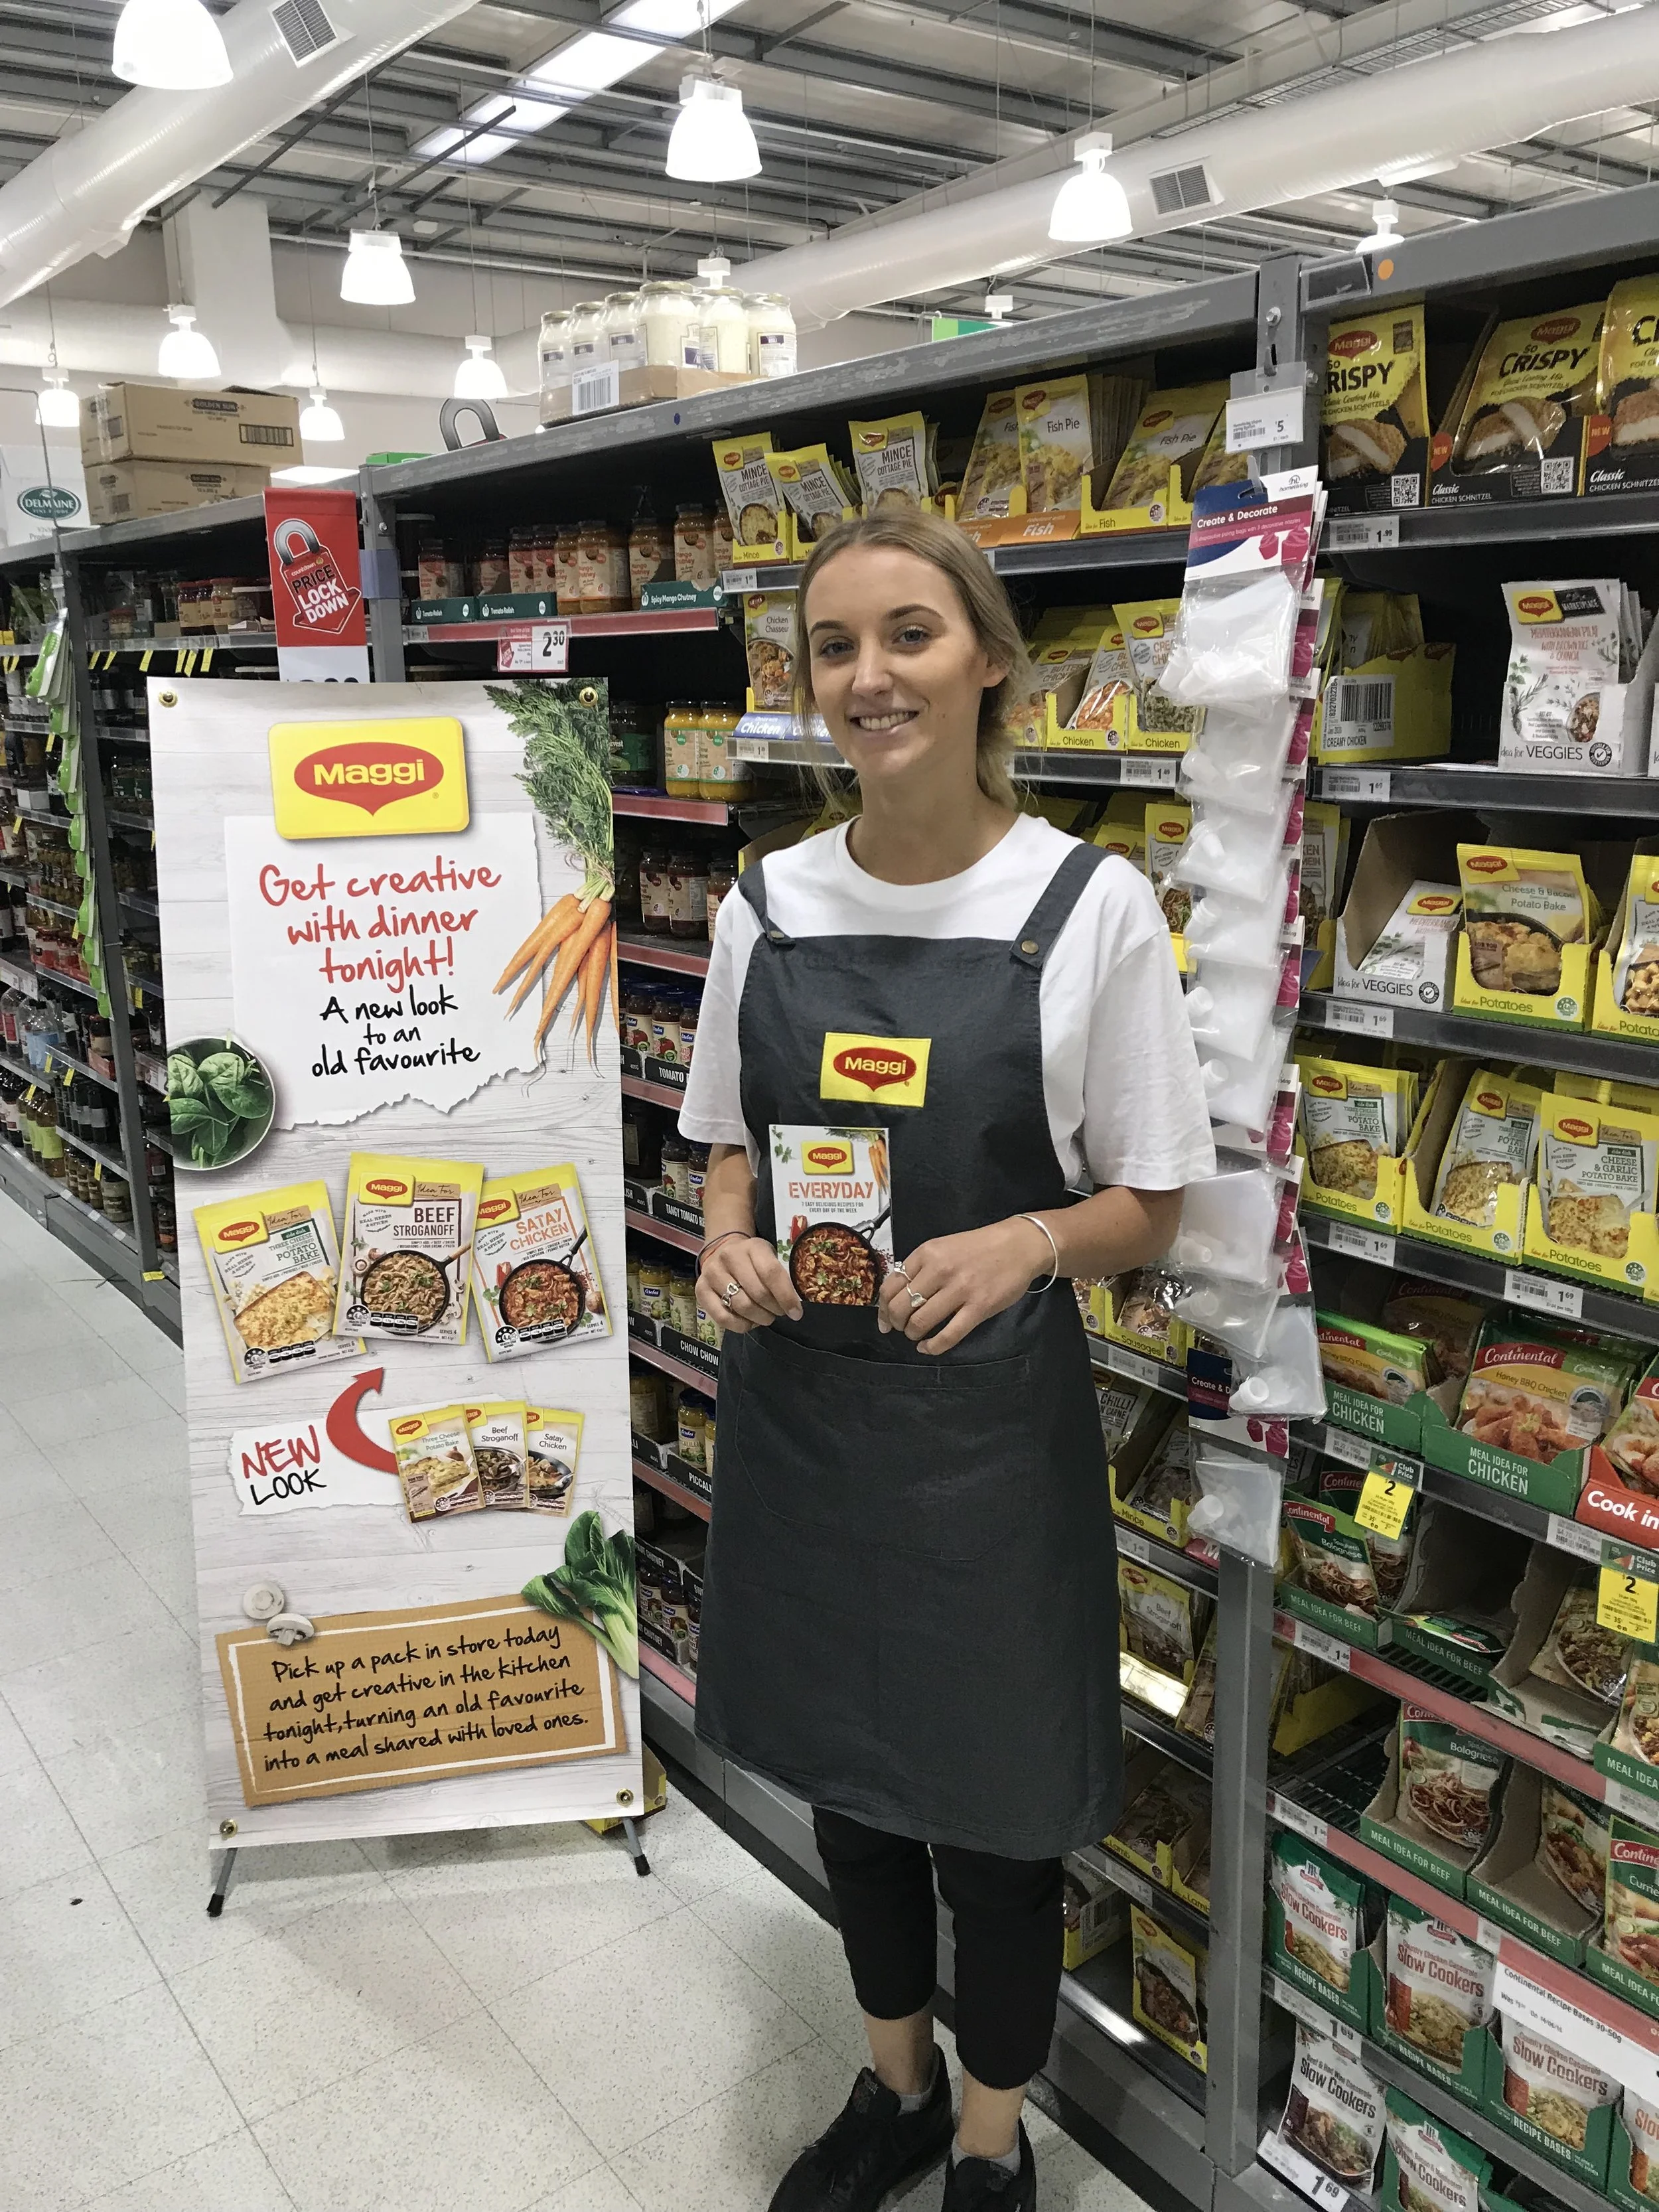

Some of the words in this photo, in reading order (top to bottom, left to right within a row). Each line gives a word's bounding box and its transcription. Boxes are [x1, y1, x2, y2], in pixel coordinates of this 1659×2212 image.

[1499, 347, 1591, 378] CRISPY
[1329, 361, 1394, 394] RISPY
[1048, 420, 1062, 432] Fish
[1064, 418, 1080, 430] Pie
[1591, 426, 1610, 437] NEW
[882, 445, 911, 464] MINCE
[1433, 446, 1447, 455] NEW
[1590, 469, 1626, 482] Classic
[1432, 483, 1460, 496] Classic
[1099, 518, 1116, 528] Fish
[1198, 513, 1226, 528] Create
[1228, 513, 1234, 522] &
[1238, 505, 1277, 519] Decorate
[291, 564, 335, 594] PRICE
[298, 578, 342, 610] LOCK
[651, 595, 661, 604] Spicy
[678, 592, 697, 602] Chutney
[305, 593, 349, 623] DOWN
[766, 616, 788, 625] Chicken
[741, 723, 780, 735] Chicken
[1062, 737, 1095, 747] Chicken
[1145, 738, 1181, 749] Chicken
[1328, 737, 1346, 747] CREAMY
[1347, 735, 1367, 746] CHICKEN
[1526, 745, 1583, 761] VEGGIES
[313, 759, 425, 786] Maggi
[259, 863, 335, 907] Get
[346, 855, 502, 899] creative
[1502, 884, 1536, 895] Cheese
[1510, 898, 1540, 910] Potato
[1543, 900, 1567, 911] Bake
[287, 905, 358, 946] with
[368, 906, 478, 938] dinner
[319, 936, 455, 993] tonight!
[1362, 978, 1413, 997] VEGGIES
[319, 995, 348, 1023] A
[356, 999, 403, 1021] new
[409, 985, 459, 1015] look
[1479, 995, 1533, 1013] Potatoes
[363, 1023, 387, 1045] to
[394, 1025, 421, 1043] an
[312, 1045, 346, 1077] old
[354, 1042, 480, 1075] favourite
[845, 1056, 907, 1075] Maggi
[659, 1067, 684, 1083] TOMATO
[1348, 1116, 1379, 1125] POTATO
[1359, 1124, 1381, 1132] BAKE
[1601, 1156, 1638, 1166] CHEESE
[1603, 1164, 1638, 1175] GARLIC
[1582, 1171, 1614, 1181] POTATO
[1616, 1173, 1638, 1183] BAKE
[371, 1183, 403, 1193] Maggi
[417, 1183, 437, 1193] Idea
[788, 1181, 874, 1199] EVERYDAY
[1316, 1192, 1357, 1212] Potatoes
[414, 1207, 455, 1223] BEEF
[516, 1208, 563, 1234] SATAY
[666, 1203, 680, 1218] TANGY
[680, 1209, 698, 1226] TOMATO
[223, 1224, 255, 1238] Maggi
[394, 1225, 455, 1237] STROGANOFF
[510, 1222, 569, 1250] CHICKEN
[1425, 1222, 1472, 1242] Potatoes
[269, 1239, 288, 1251] THREE
[289, 1233, 313, 1245] CHEESE
[277, 1243, 317, 1261] POTATO
[294, 1250, 319, 1264] BAKE
[1550, 1249, 1602, 1272] Potatoes
[680, 1339, 698, 1357] CHOW
[699, 1348, 719, 1366] CHOW
[1121, 1334, 1161, 1357] Sausages
[1484, 1346, 1558, 1364] Continental
[1496, 1370, 1519, 1384] Honey
[1520, 1377, 1537, 1390] BBQ
[1538, 1382, 1567, 1398] Chicken
[1334, 1390, 1350, 1406] MEAL
[1352, 1397, 1369, 1411] IDEA
[1370, 1403, 1384, 1417] FOR
[1333, 1401, 1384, 1434] CHICKEN
[481, 1434, 519, 1443] Stroganoff
[539, 1440, 567, 1450] Chicken
[544, 1434, 564, 1443] Satay
[241, 1425, 321, 1479] NEW
[1470, 1447, 1490, 1463] MEAL
[1493, 1455, 1510, 1470] IDEA
[1512, 1462, 1528, 1477] FOR
[1398, 1463, 1414, 1473] Club
[1398, 1469, 1413, 1479] Price
[1468, 1459, 1528, 1495] CHICKEN
[250, 1469, 326, 1506] LOOK
[1587, 1491, 1639, 1522] Cook
[1121, 1509, 1144, 1527] Mince
[1321, 1538, 1362, 1559] Bolognese
[1291, 1593, 1309, 1609] MEAL
[1311, 1601, 1328, 1617] IDEA
[1329, 1610, 1342, 1624] FOR
[1344, 1617, 1362, 1633] BEEF
[271, 1659, 319, 1683] Pick
[325, 1661, 345, 1681] up
[351, 1656, 365, 1669] a
[370, 1640, 421, 1674] pack
[425, 1643, 442, 1660] in
[446, 1634, 500, 1657] store
[504, 1625, 562, 1651] today
[269, 1690, 306, 1712] and
[313, 1682, 347, 1712] get
[351, 1674, 436, 1700] creative
[439, 1670, 455, 1686] in
[459, 1659, 495, 1682] the
[498, 1654, 571, 1678] kitchen
[423, 1702, 449, 1720] an
[455, 1690, 483, 1714] old
[486, 1678, 585, 1710] favourite
[263, 1750, 300, 1773] into
[307, 1750, 320, 1765] a
[326, 1739, 370, 1762] meal
[374, 1730, 442, 1757] shared
[447, 1718, 488, 1743] with
[491, 1716, 537, 1739] loved
[543, 1714, 589, 1730] ones.
[1450, 1741, 1499, 1764] Bolognese
[1371, 1830, 1391, 1849] MEAL
[1394, 1842, 1411, 1860] IDEA
[1413, 1852, 1429, 1870] FOR
[1430, 1862, 1451, 1881] BEEF
[1479, 1889, 1500, 1909] MEAL
[1502, 1903, 1520, 1922] IDEA
[1523, 1918, 1539, 1934] FOR
[1541, 1928, 1561, 1947] BEEF
[1398, 1944, 1424, 1974] Slow
[1429, 1960, 1484, 1998] Cookers
[1504, 1968, 1546, 1997] Continental
[1548, 1993, 1572, 2013] Recipe
[1573, 2008, 1593, 2026] Bases
[1597, 2023, 1623, 2043] 30-50g
[1514, 2036, 1545, 2069] Slow
[1547, 2055, 1609, 2096] Cookers
[1300, 2057, 1326, 2092] Slow
[1327, 2077, 1376, 2119] Cookers
[1514, 2116, 1542, 2142] RECIPE
[1544, 2135, 1571, 2160] BASES
[1417, 2160, 1467, 2208] Cookers
